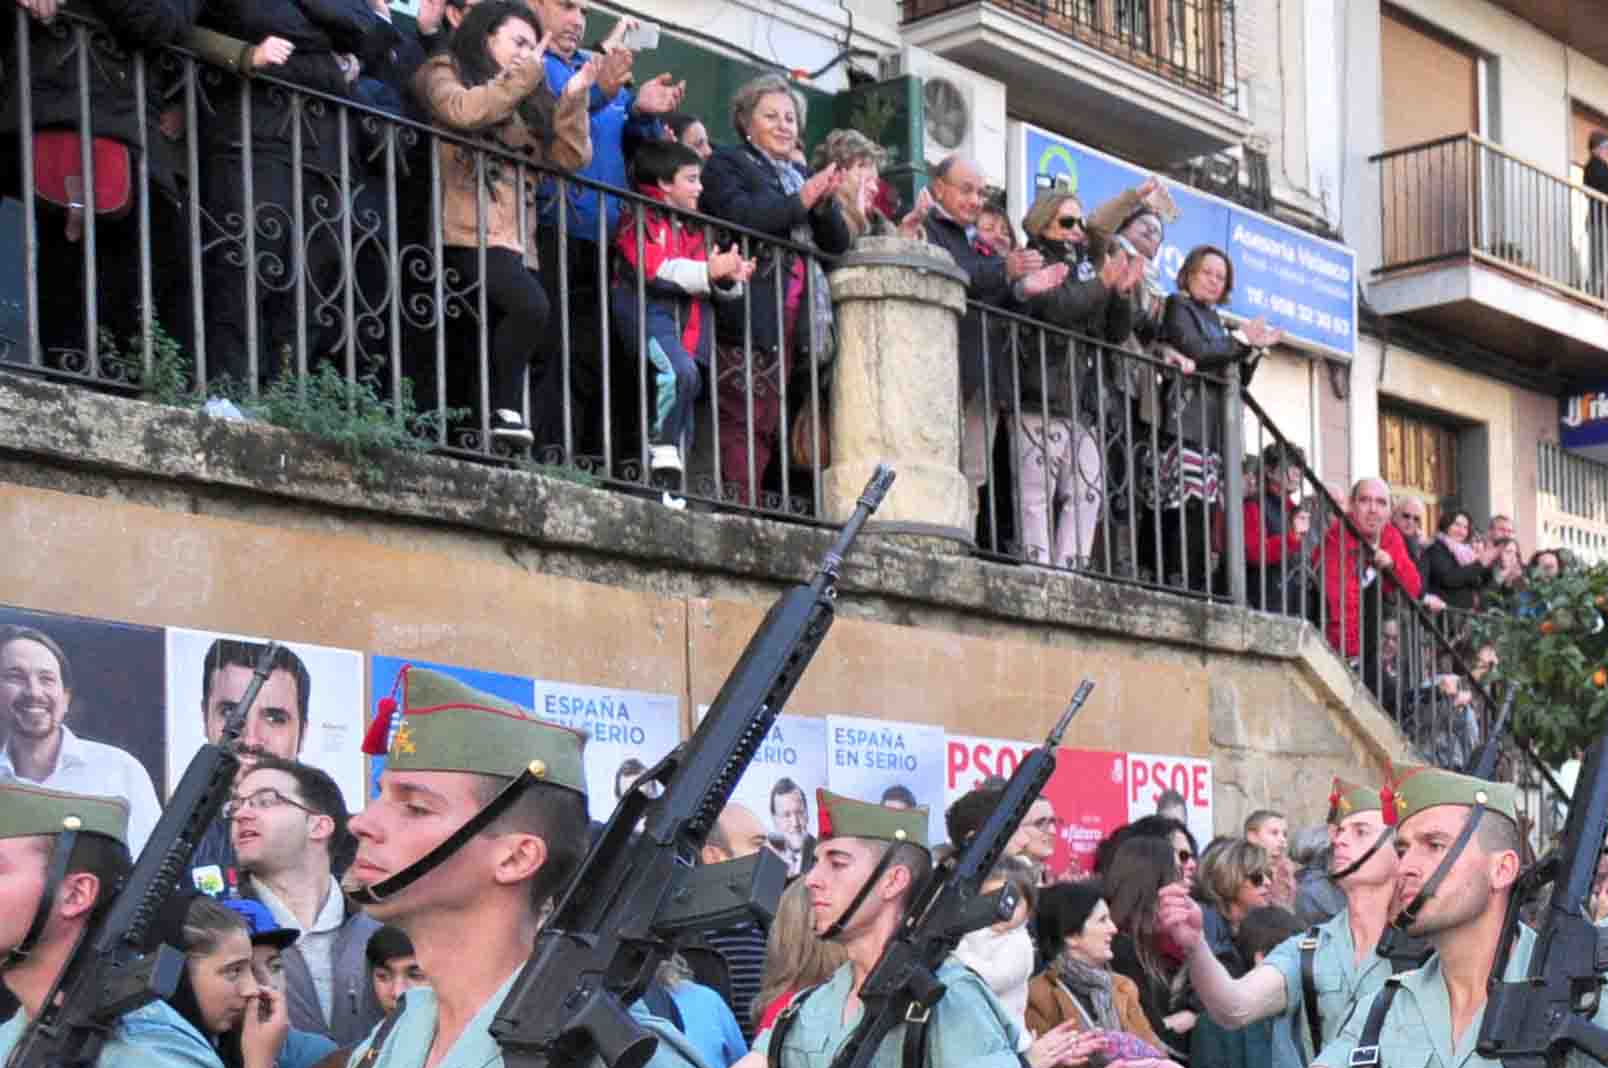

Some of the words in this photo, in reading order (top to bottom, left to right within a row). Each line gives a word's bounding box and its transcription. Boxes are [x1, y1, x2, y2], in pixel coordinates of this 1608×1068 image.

[544, 694, 630, 721] ESPAÑA
[584, 721, 645, 745] ERIO
[835, 727, 905, 750] ESPAÑA
[835, 750, 859, 767] EN
[865, 752, 917, 772] SERIO
[947, 741, 1031, 791] PSO
[1131, 760, 1209, 807] PSOE
